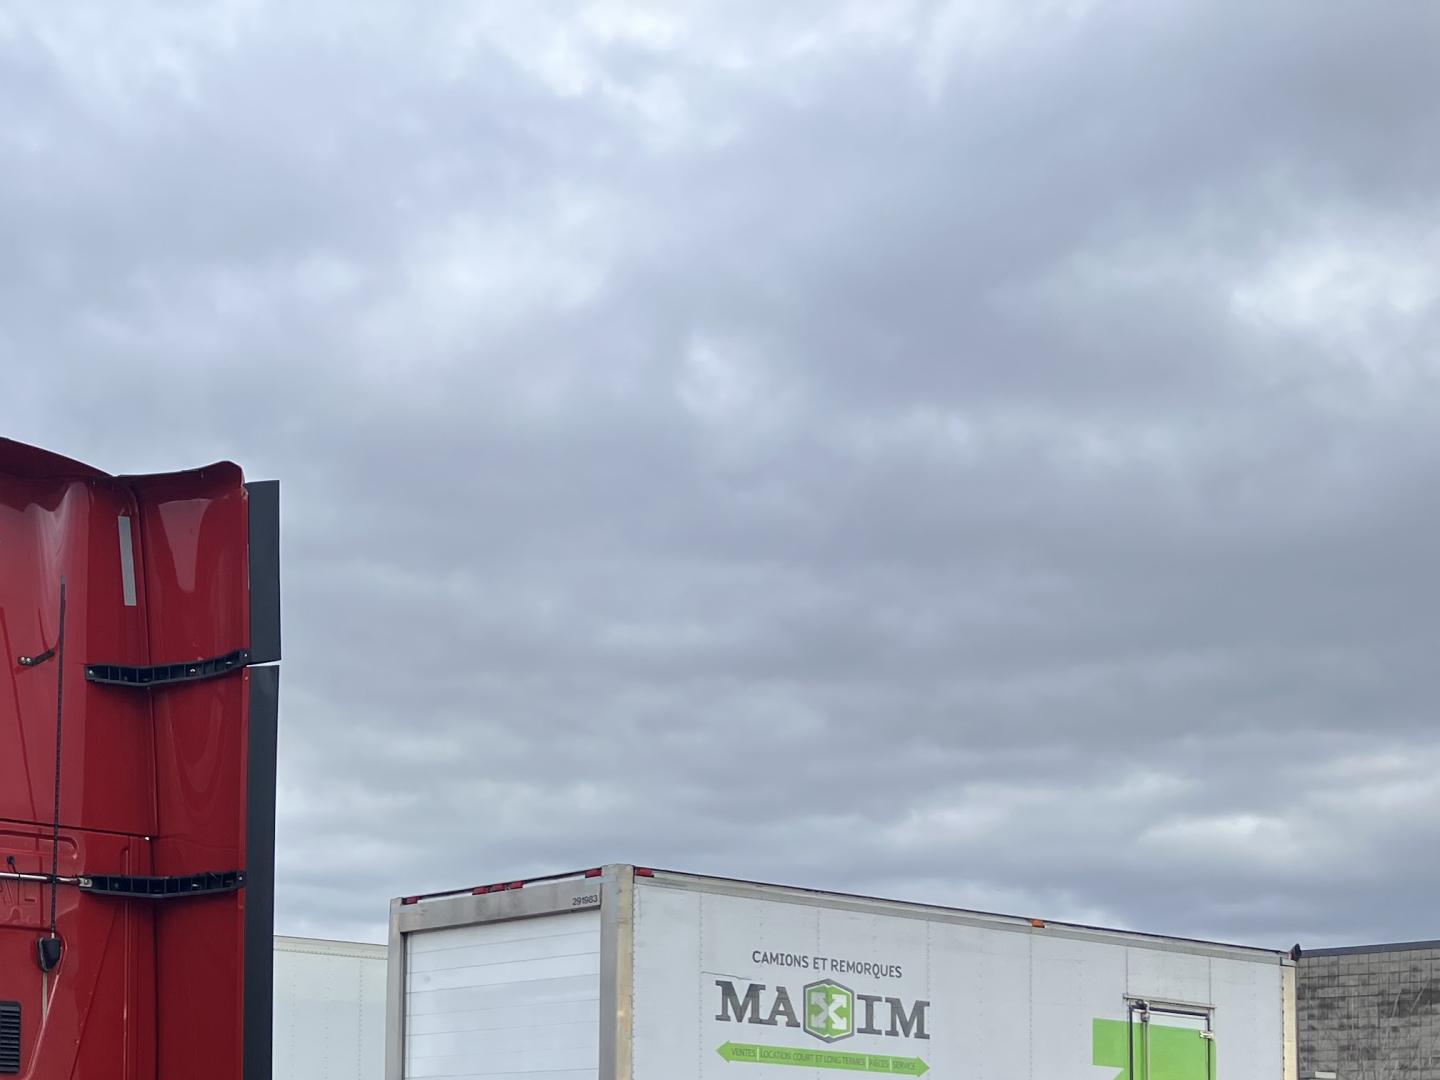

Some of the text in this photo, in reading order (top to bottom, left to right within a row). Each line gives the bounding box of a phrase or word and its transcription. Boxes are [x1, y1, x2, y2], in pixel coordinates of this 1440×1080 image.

[752, 950, 903, 979] CAMIONS ET REMORQUES
[714, 979, 931, 1043] MAXIM
